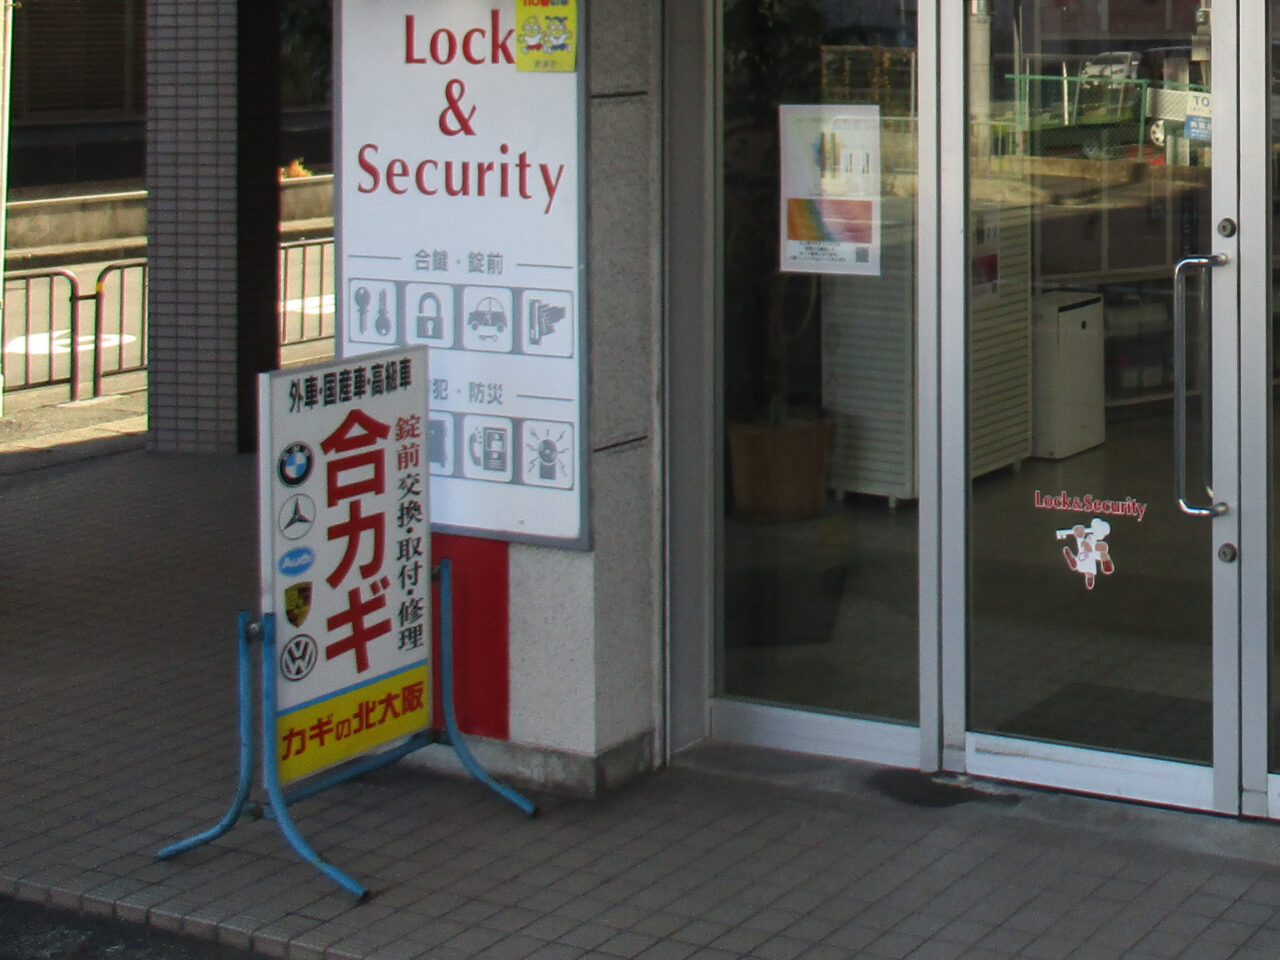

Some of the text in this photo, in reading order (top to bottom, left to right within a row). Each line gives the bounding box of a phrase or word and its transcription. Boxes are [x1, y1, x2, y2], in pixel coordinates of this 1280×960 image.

[405, 8, 515, 65] Lock
[438, 78, 478, 137] &
[357, 143, 566, 215] Security
[320, 408, 392, 675] 合カギ
[281, 680, 425, 761] カギの北大阪
